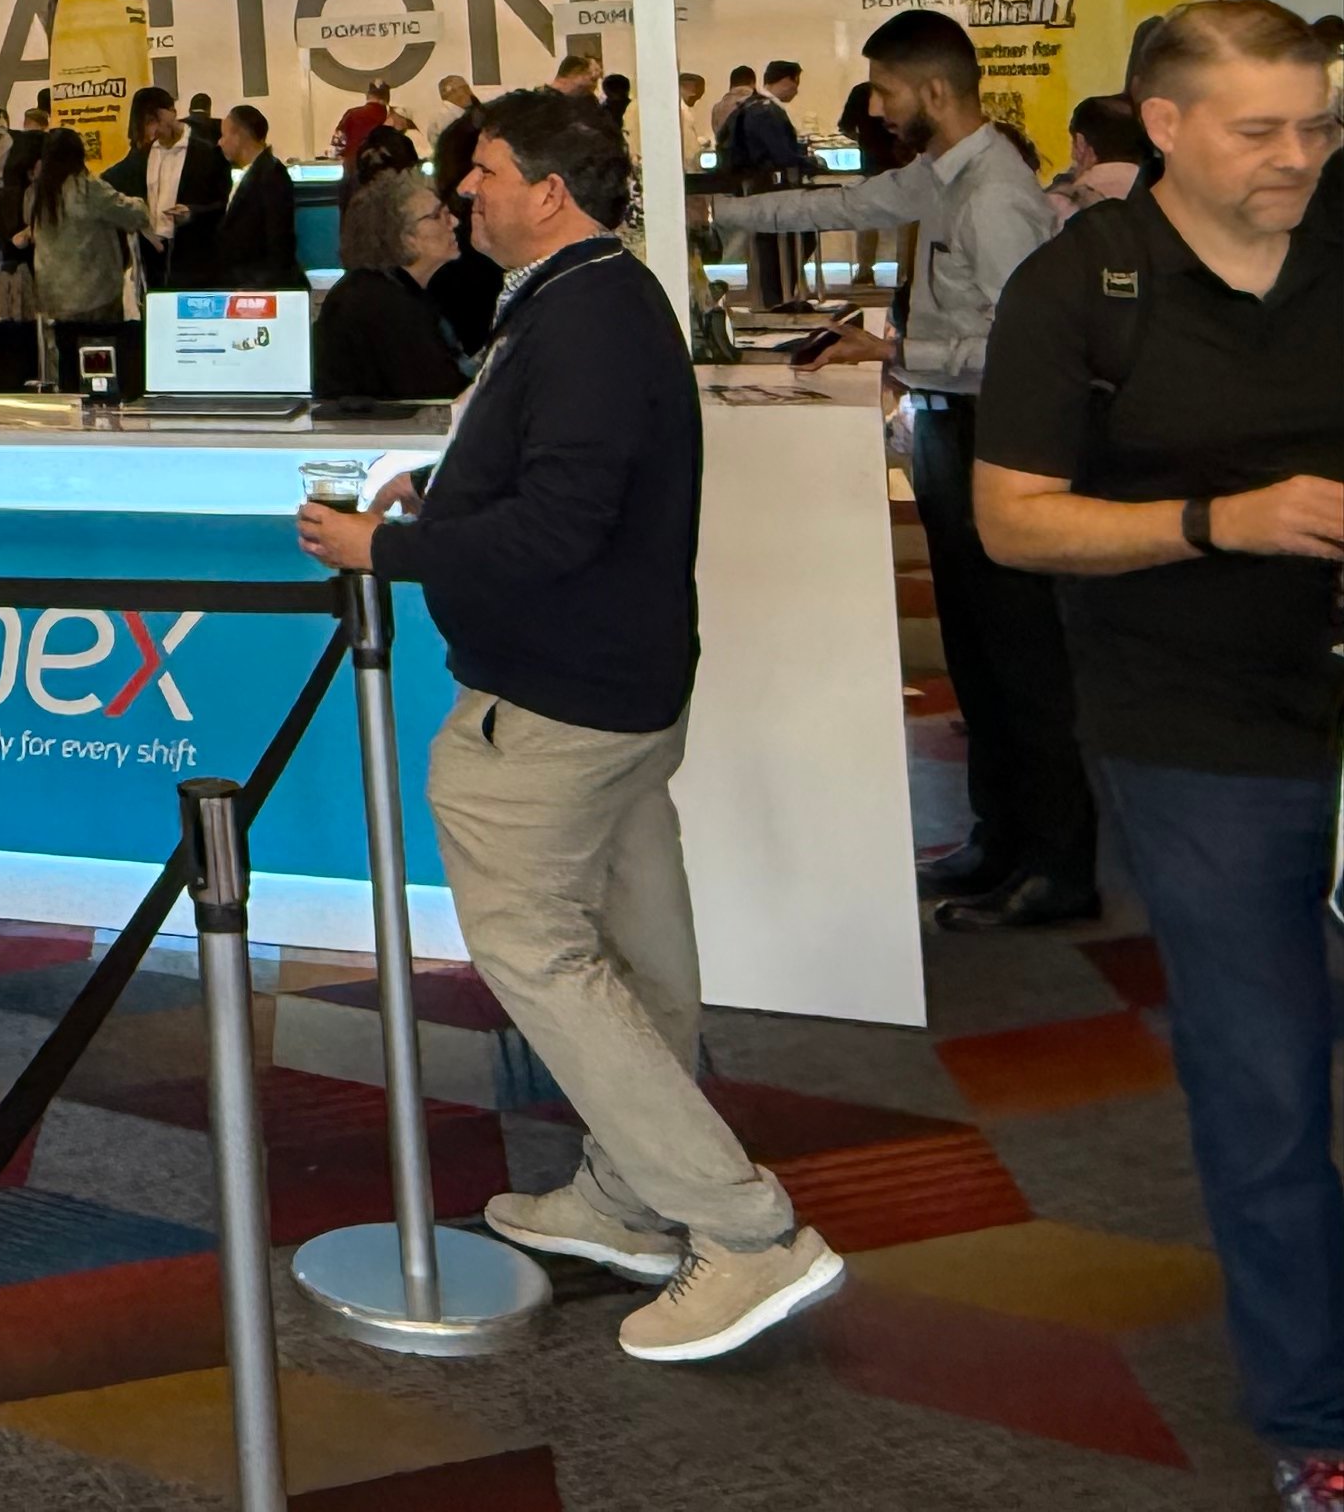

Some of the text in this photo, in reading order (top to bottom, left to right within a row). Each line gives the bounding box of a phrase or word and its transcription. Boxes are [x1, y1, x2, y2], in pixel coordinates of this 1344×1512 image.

[320, 21, 421, 40] DOMESTIC
[16, 729, 57, 762] for
[61, 738, 131, 768] every
[136, 738, 197, 773] shift
